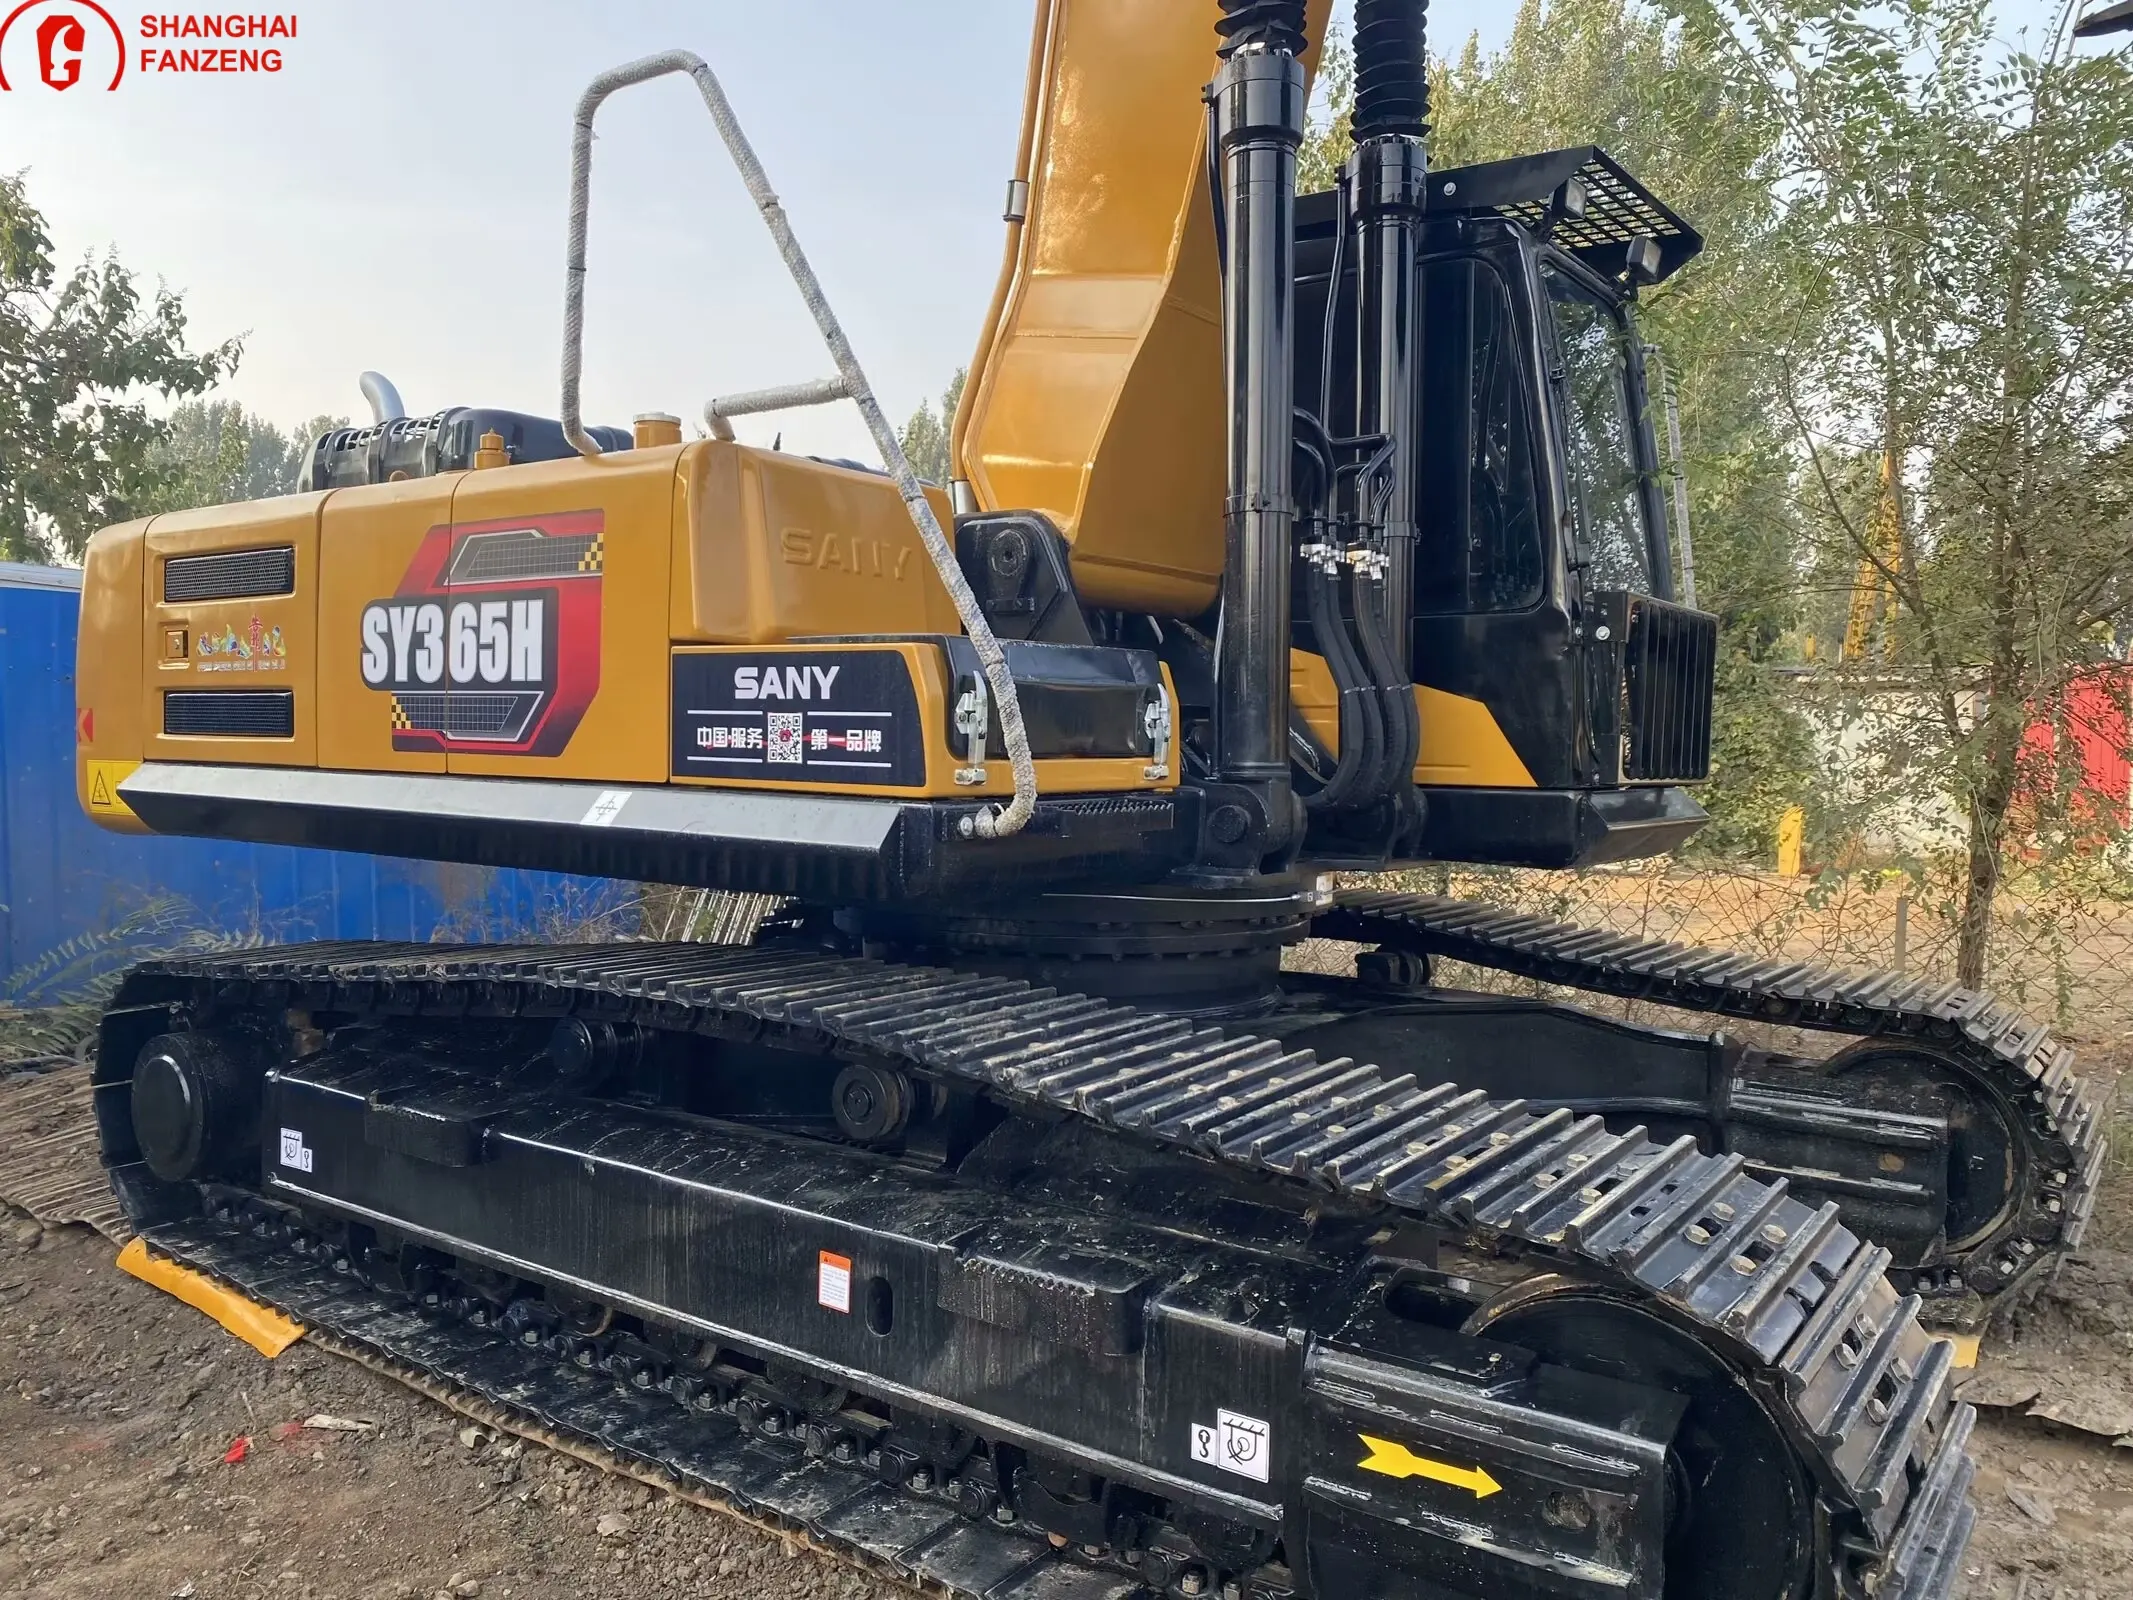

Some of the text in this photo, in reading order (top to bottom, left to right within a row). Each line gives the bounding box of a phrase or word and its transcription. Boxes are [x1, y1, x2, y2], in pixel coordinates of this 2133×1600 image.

[780, 527, 912, 582] SANY
[362, 599, 544, 684] SY365H
[734, 666, 840, 700] SANY
[811, 728, 882, 753] 第一品牌
